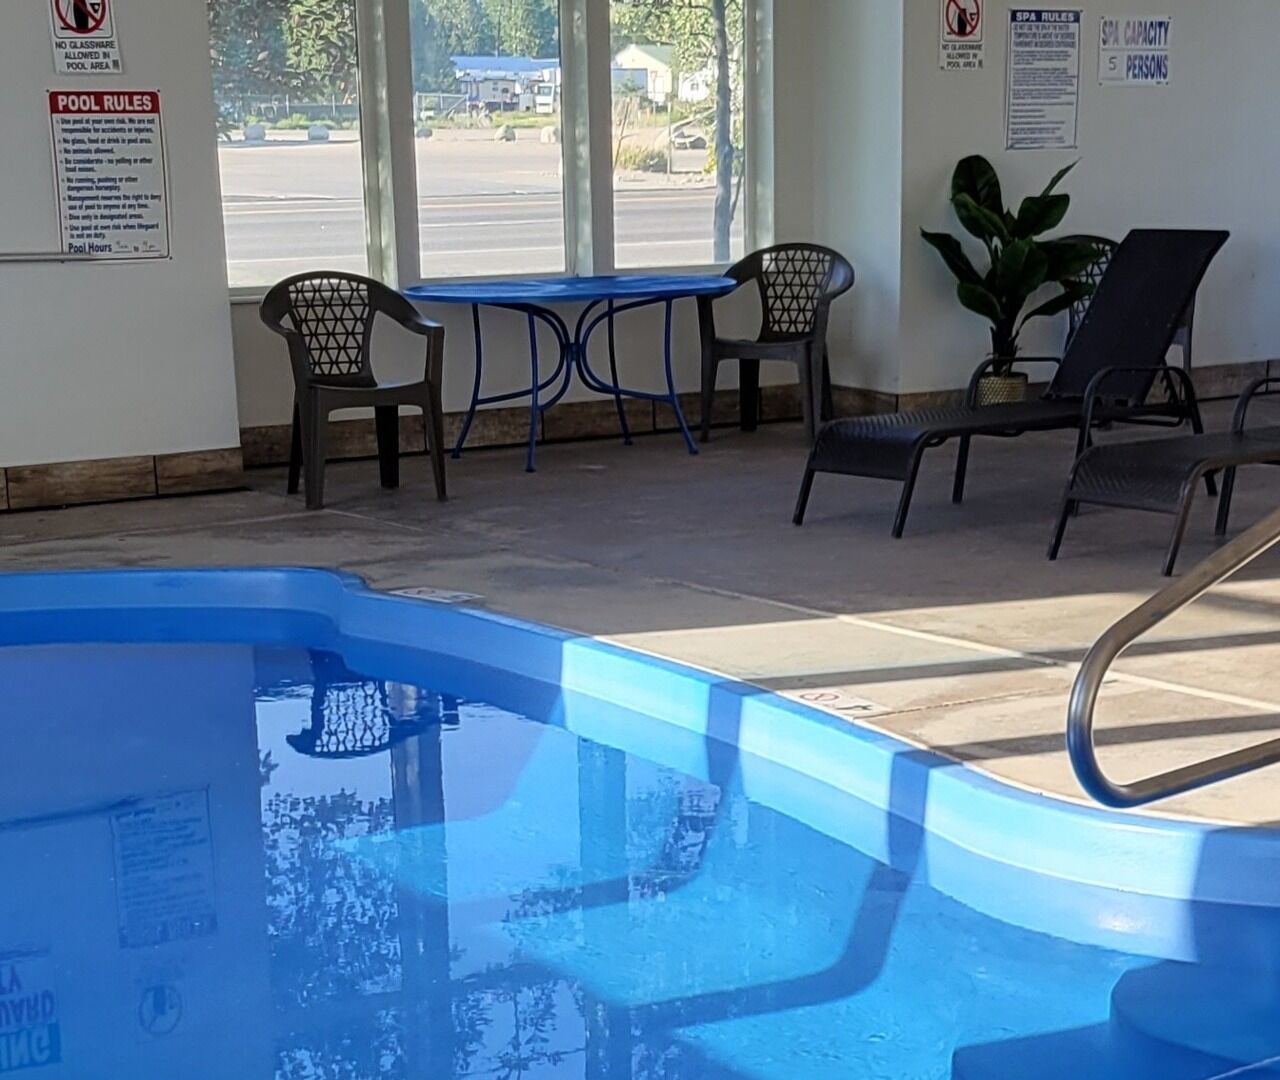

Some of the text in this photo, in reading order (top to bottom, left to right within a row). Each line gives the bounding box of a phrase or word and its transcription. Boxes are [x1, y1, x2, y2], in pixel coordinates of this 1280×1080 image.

[1016, 12, 1075, 22] SPA RULES
[1102, 20, 1170, 47] SPA CAPACITY
[55, 41, 116, 50] NO GLASSWARE
[64, 51, 111, 60] ALLOWED IN
[66, 61, 88, 70] POOL
[90, 61, 111, 70] AREA
[1126, 54, 1169, 80] PERSONS
[57, 95, 153, 111] POOL RULES
[68, 242, 86, 253] Pool
[88, 242, 113, 253] Hours
